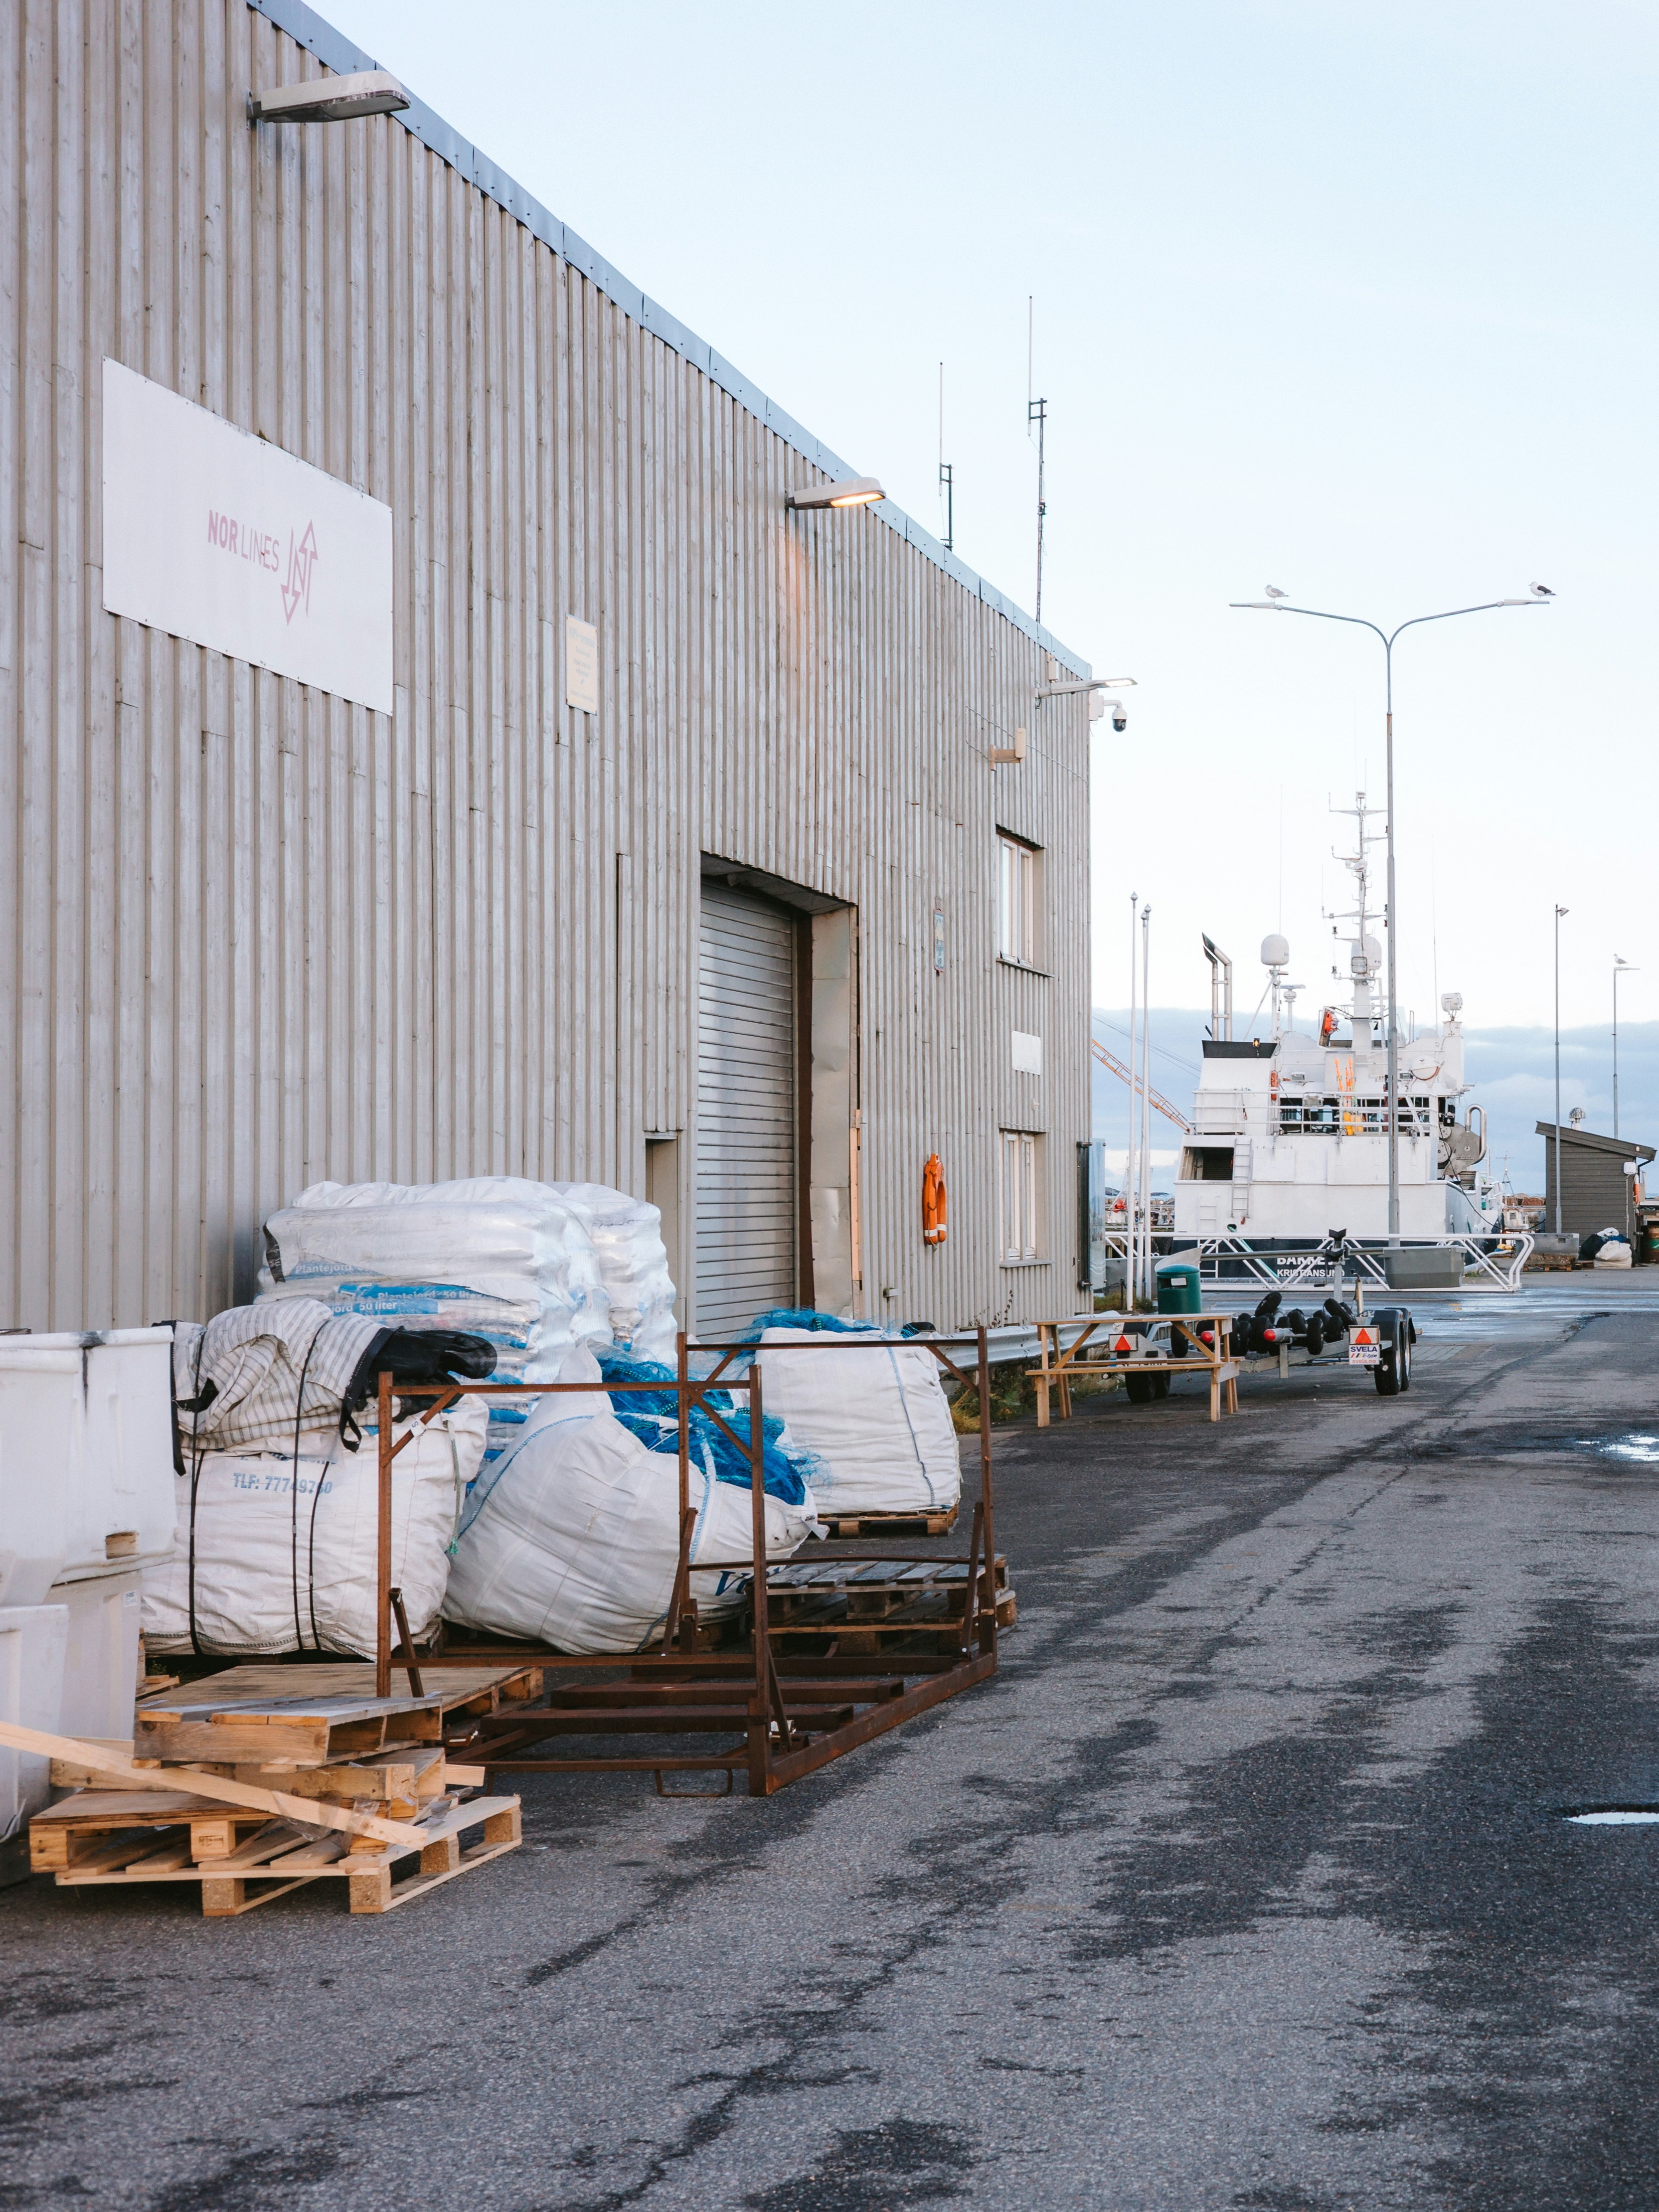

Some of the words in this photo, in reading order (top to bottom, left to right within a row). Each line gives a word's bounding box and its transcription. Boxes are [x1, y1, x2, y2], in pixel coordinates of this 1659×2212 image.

[208, 509, 238, 554] NOR
[241, 524, 279, 572] LINES
[1277, 1269, 1345, 1277] KRISTANSUD
[443, 1291, 456, 1299] 50
[360, 1302, 373, 1311] 50
[375, 1301, 397, 1310] liter
[233, 1472, 259, 1489] TLF:
